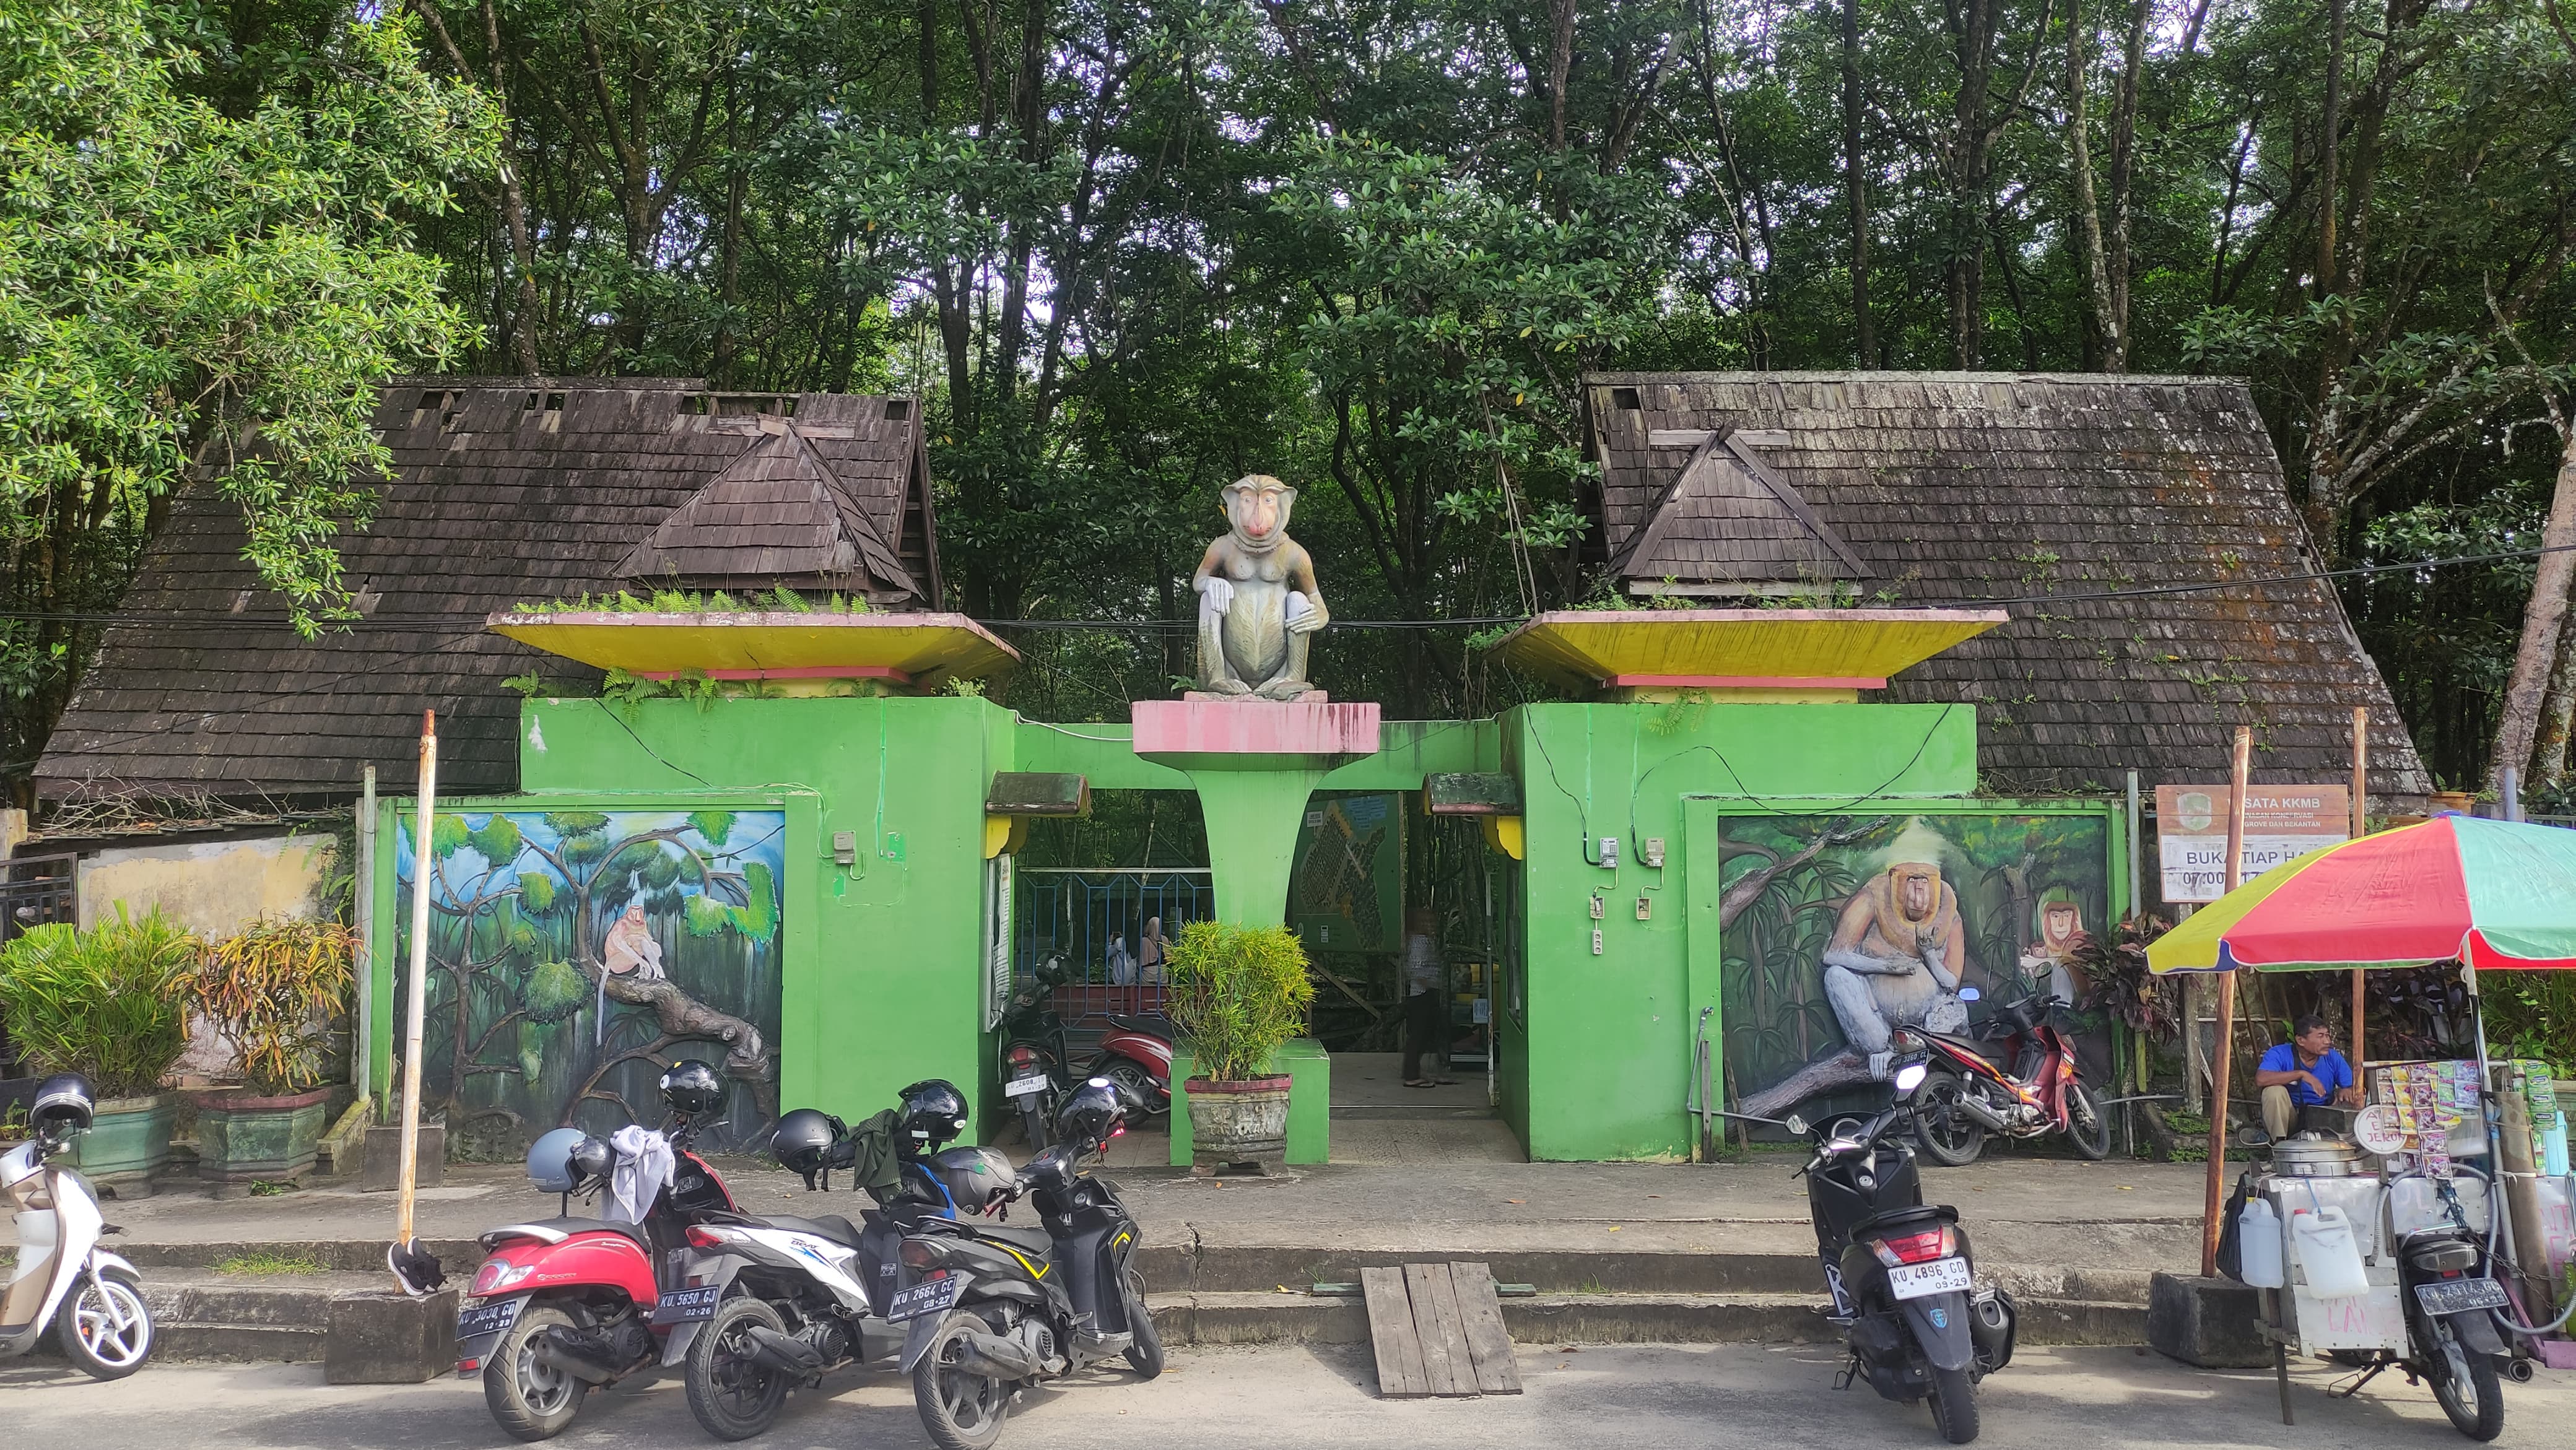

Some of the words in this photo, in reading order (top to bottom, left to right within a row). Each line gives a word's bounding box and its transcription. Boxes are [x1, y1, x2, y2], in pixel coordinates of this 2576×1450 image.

[2282, 798, 2320, 809] KKMB
[2242, 851, 2278, 864] TIAP
[1891, 1270, 1908, 1283] KU
[1915, 1264, 1943, 1280] 4896
[1949, 1261, 1965, 1274] GD
[660, 1295, 674, 1308] KU
[677, 1292, 700, 1306] 5650
[894, 1292, 908, 1306] KU
[912, 1284, 936, 1301] 2664
